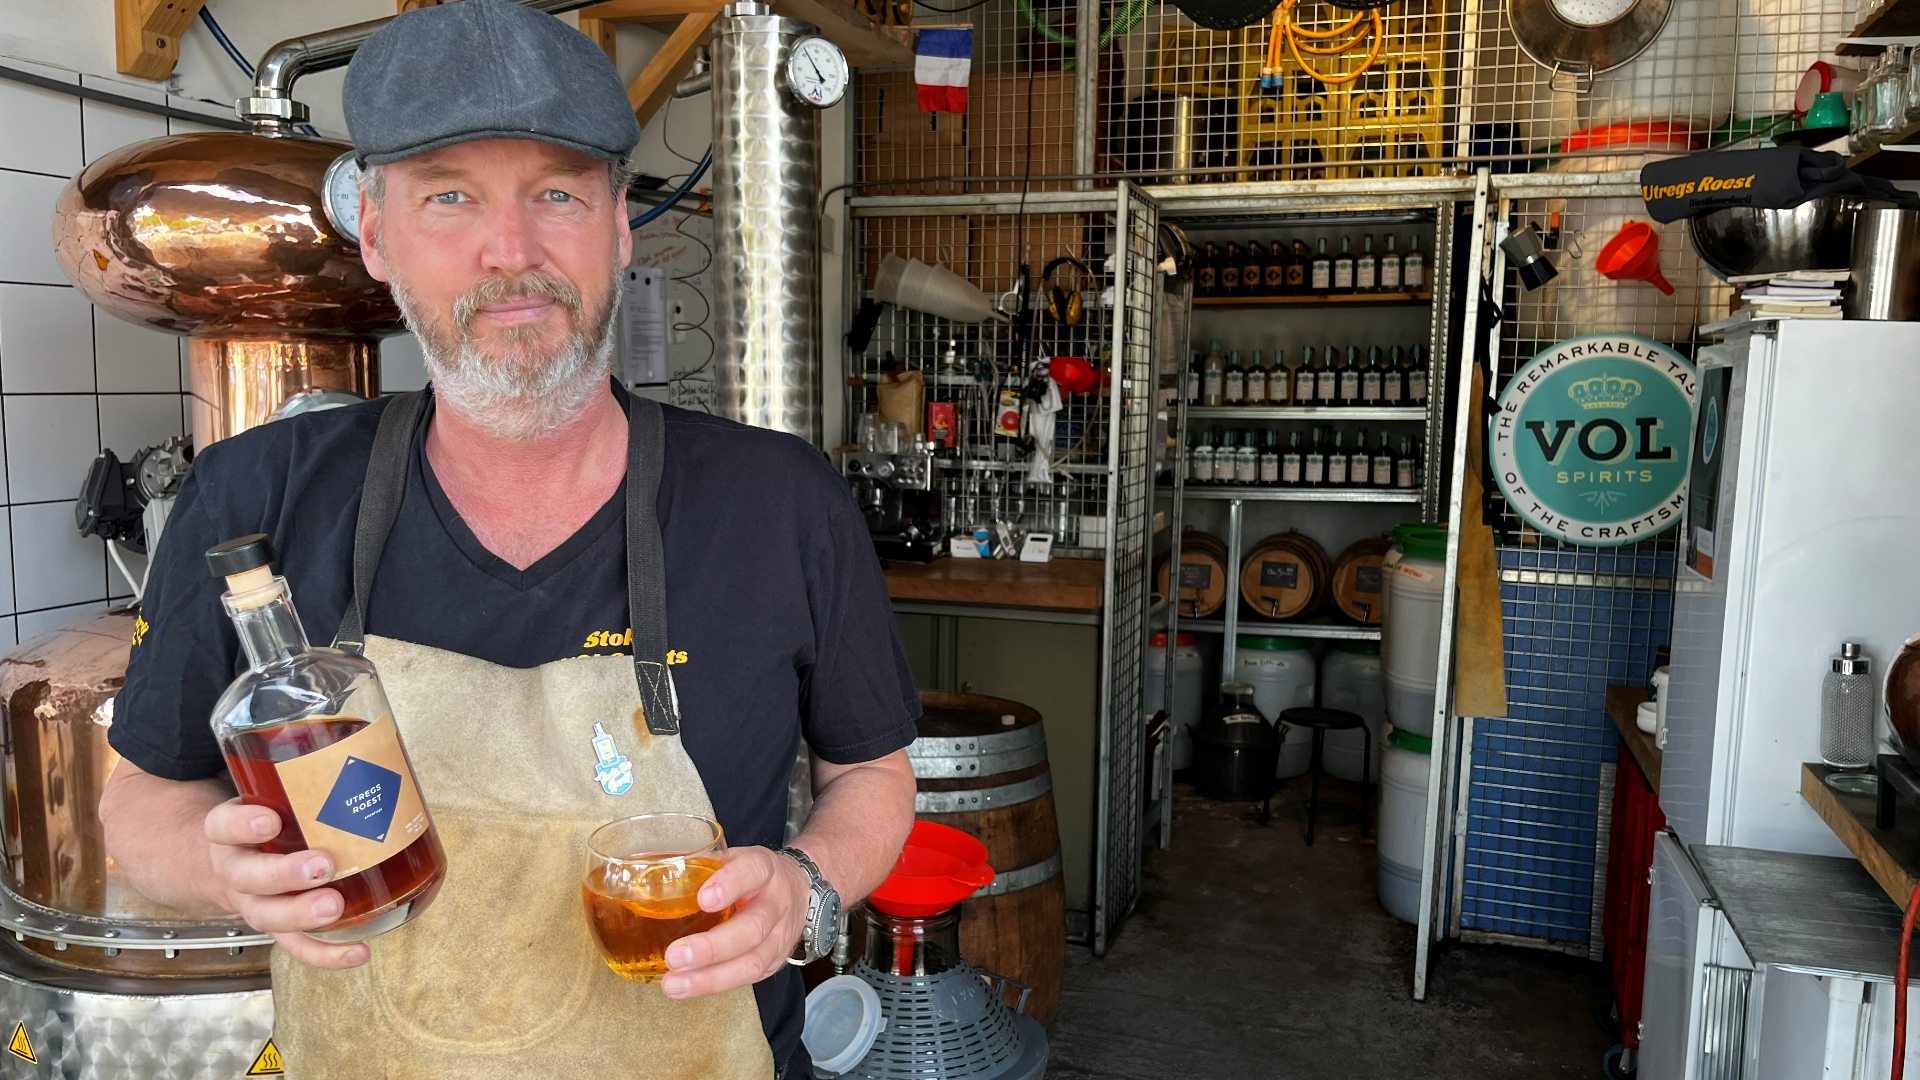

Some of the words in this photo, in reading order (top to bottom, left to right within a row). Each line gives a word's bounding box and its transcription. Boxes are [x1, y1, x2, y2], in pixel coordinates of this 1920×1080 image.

[1642, 182, 1696, 201] Utregs
[1697, 174, 1756, 192] Roest
[1498, 401, 1518, 441] THE
[1516, 341, 1660, 394] REMARKABLE
[1667, 361, 1697, 396] TAS
[1525, 416, 1675, 464] VOL
[1556, 469, 1653, 484] SPIRITS
[1504, 471, 1527, 497] OF
[1530, 502, 1569, 533] THE
[1580, 493, 1686, 540] CRAFTSM
[583, 627, 633, 648] Stok
[345, 783, 382, 807] UTREGS
[352, 793, 383, 814] ROEST
